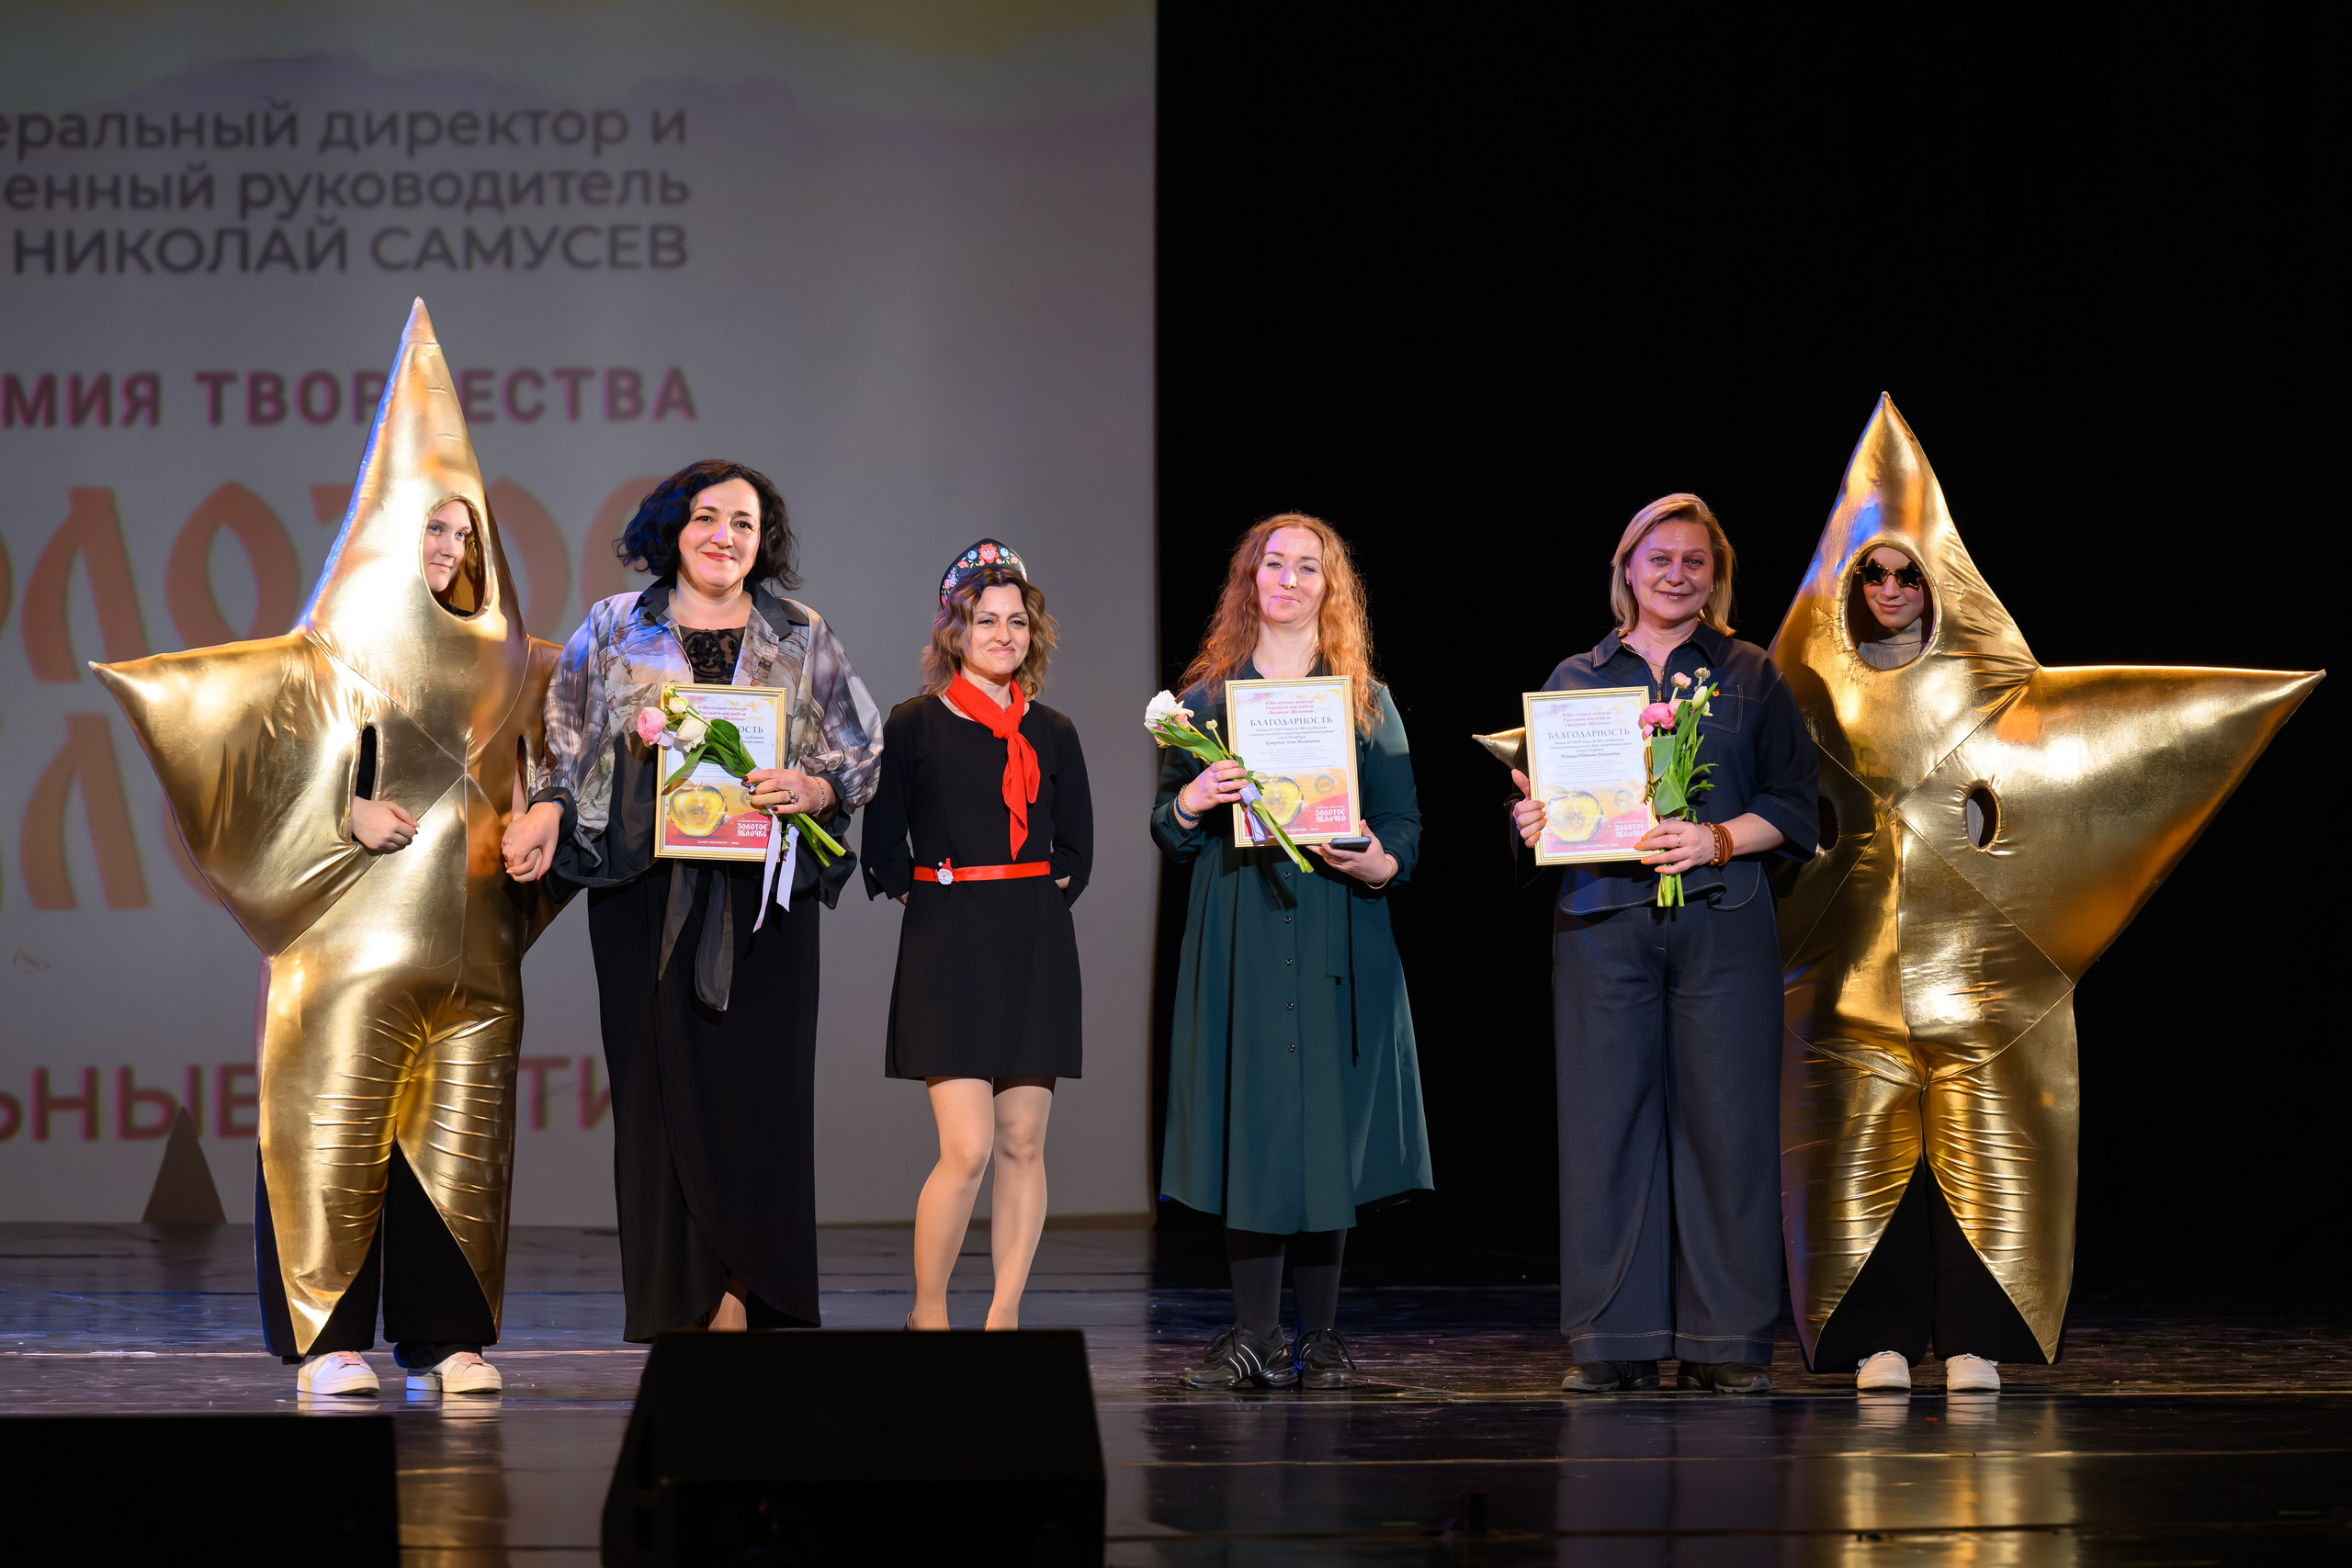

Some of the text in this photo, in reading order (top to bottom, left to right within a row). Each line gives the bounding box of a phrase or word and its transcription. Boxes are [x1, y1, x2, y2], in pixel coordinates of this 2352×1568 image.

[318, 109, 630, 159] директор
[651, 108, 687, 145] и
[239, 169, 691, 221] руководитель
[13, 213, 689, 275] НИКОЛАЙ САМУСЕВ
[193, 366, 698, 429] ТВОРЕСТВА
[1250, 716, 1333, 727] БЛАГОДАРНОСТЬ
[1548, 728, 1630, 739] БЛАГОДАРНОСТЬ
[1316, 815, 1347, 823] ЯБЛОЧКО
